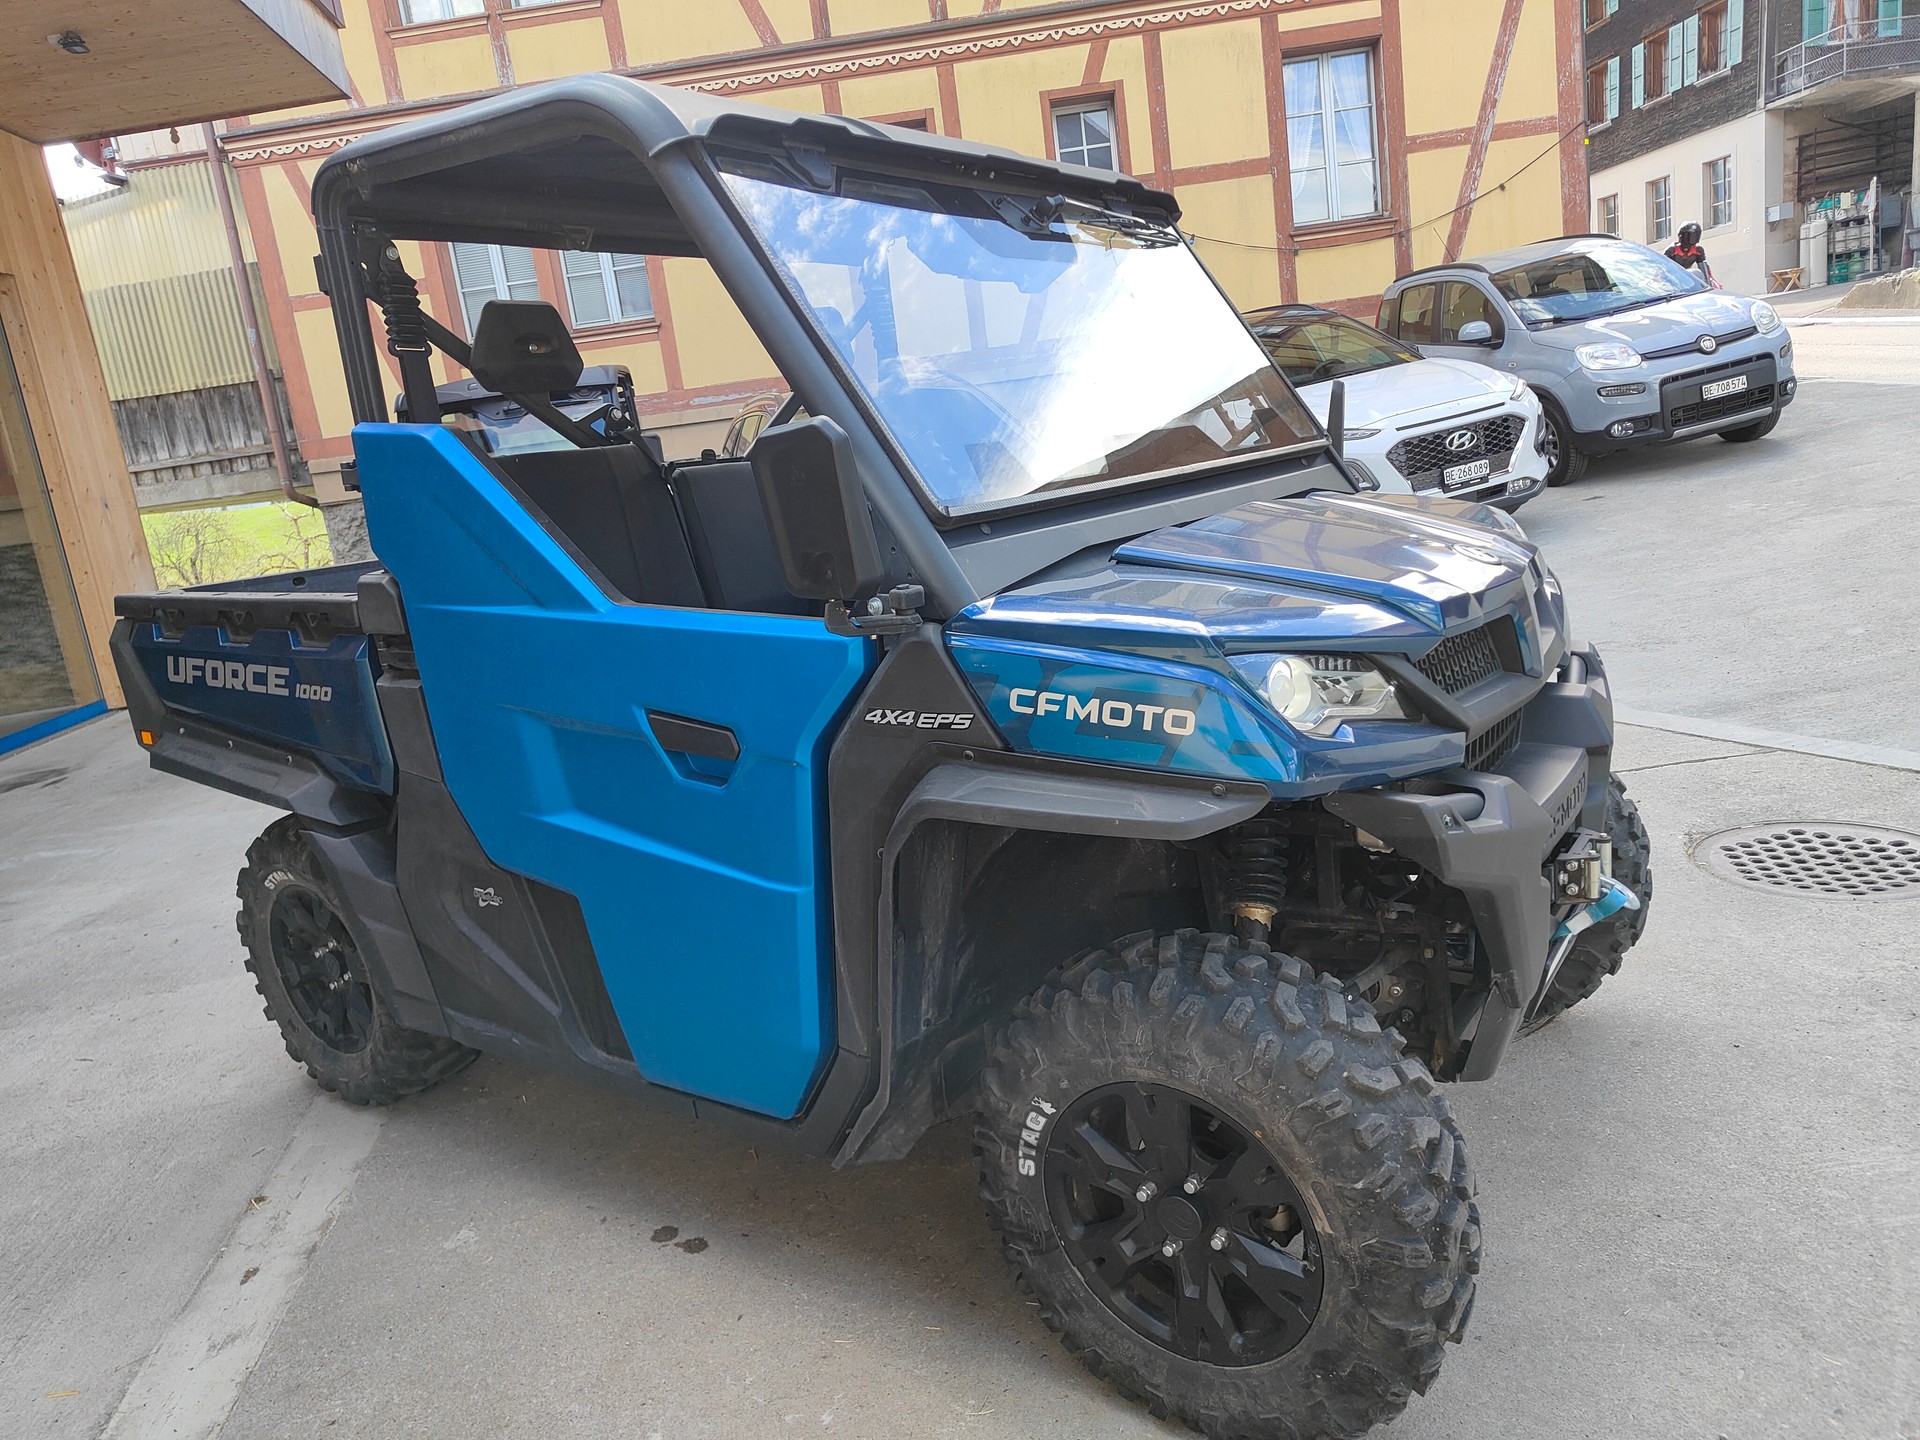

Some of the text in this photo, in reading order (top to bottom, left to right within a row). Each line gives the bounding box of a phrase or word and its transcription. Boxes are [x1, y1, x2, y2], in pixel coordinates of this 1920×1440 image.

[166, 655, 332, 702] UFORCE 1000
[916, 713, 975, 730] EPS
[1009, 687, 1196, 737] CFMOTO
[1549, 771, 1586, 838] FMOTO
[1018, 1111, 1048, 1177] STAG
